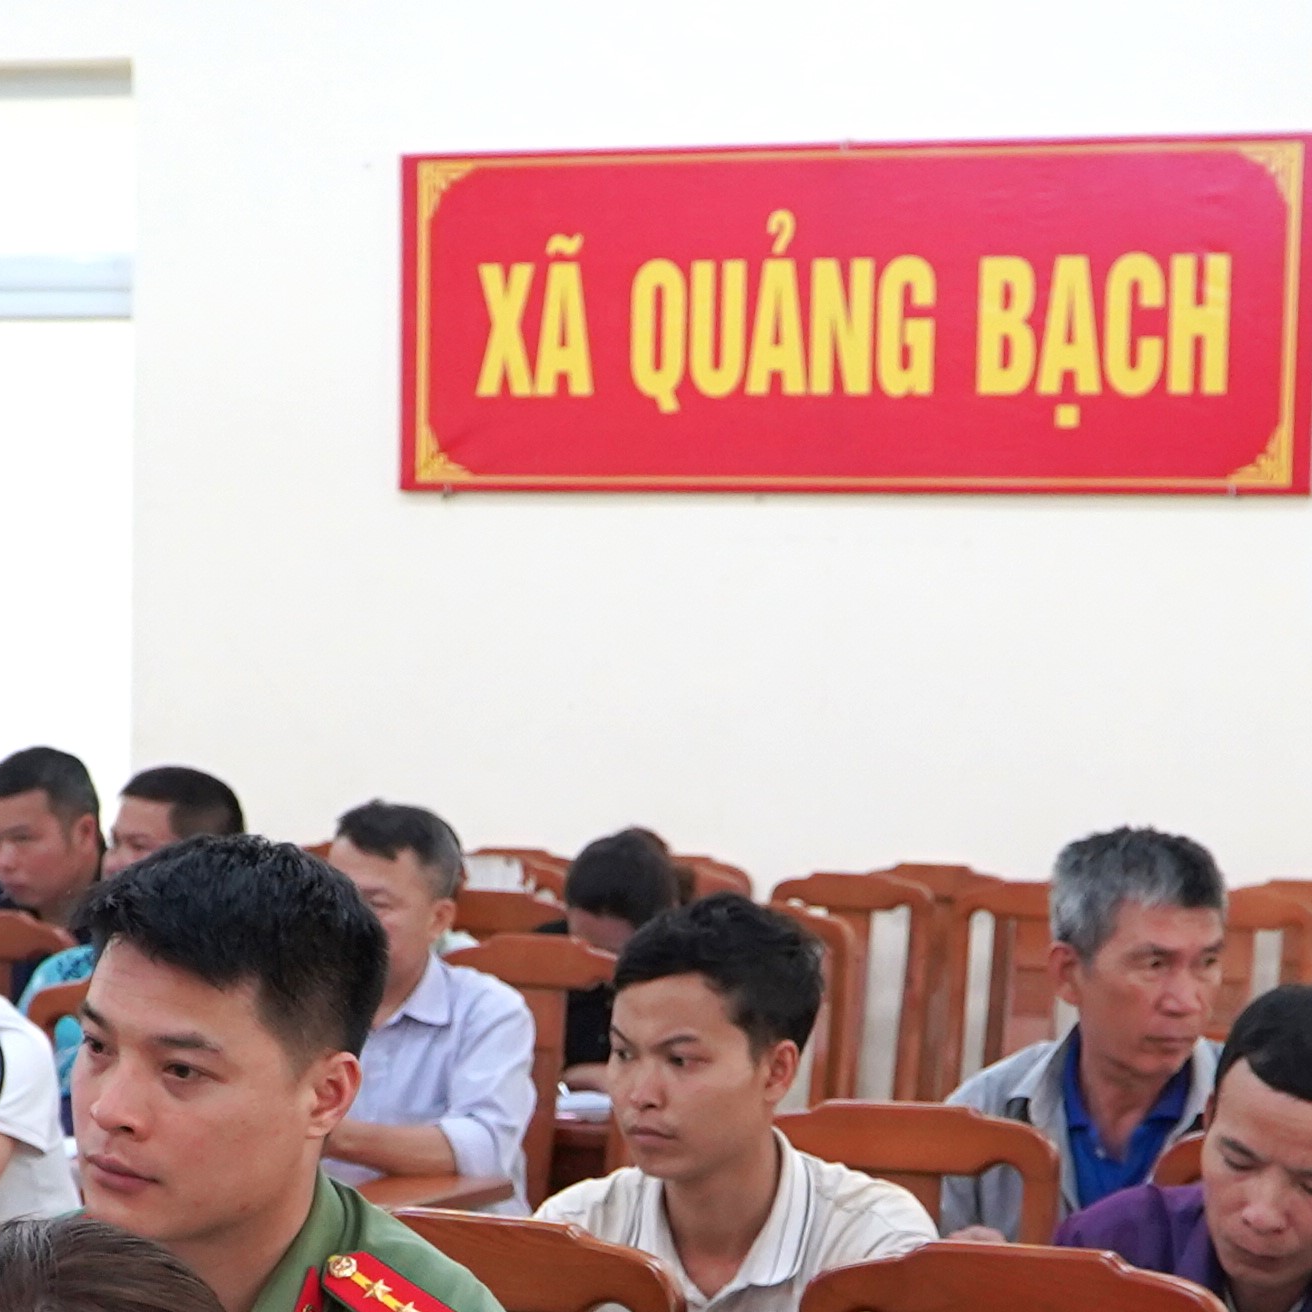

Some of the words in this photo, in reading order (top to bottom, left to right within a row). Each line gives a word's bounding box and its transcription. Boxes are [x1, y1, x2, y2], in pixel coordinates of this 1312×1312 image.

[475, 233, 594, 397] XÃ
[629, 209, 936, 413] QUẢNG
[976, 252, 1232, 428] BẠCH
